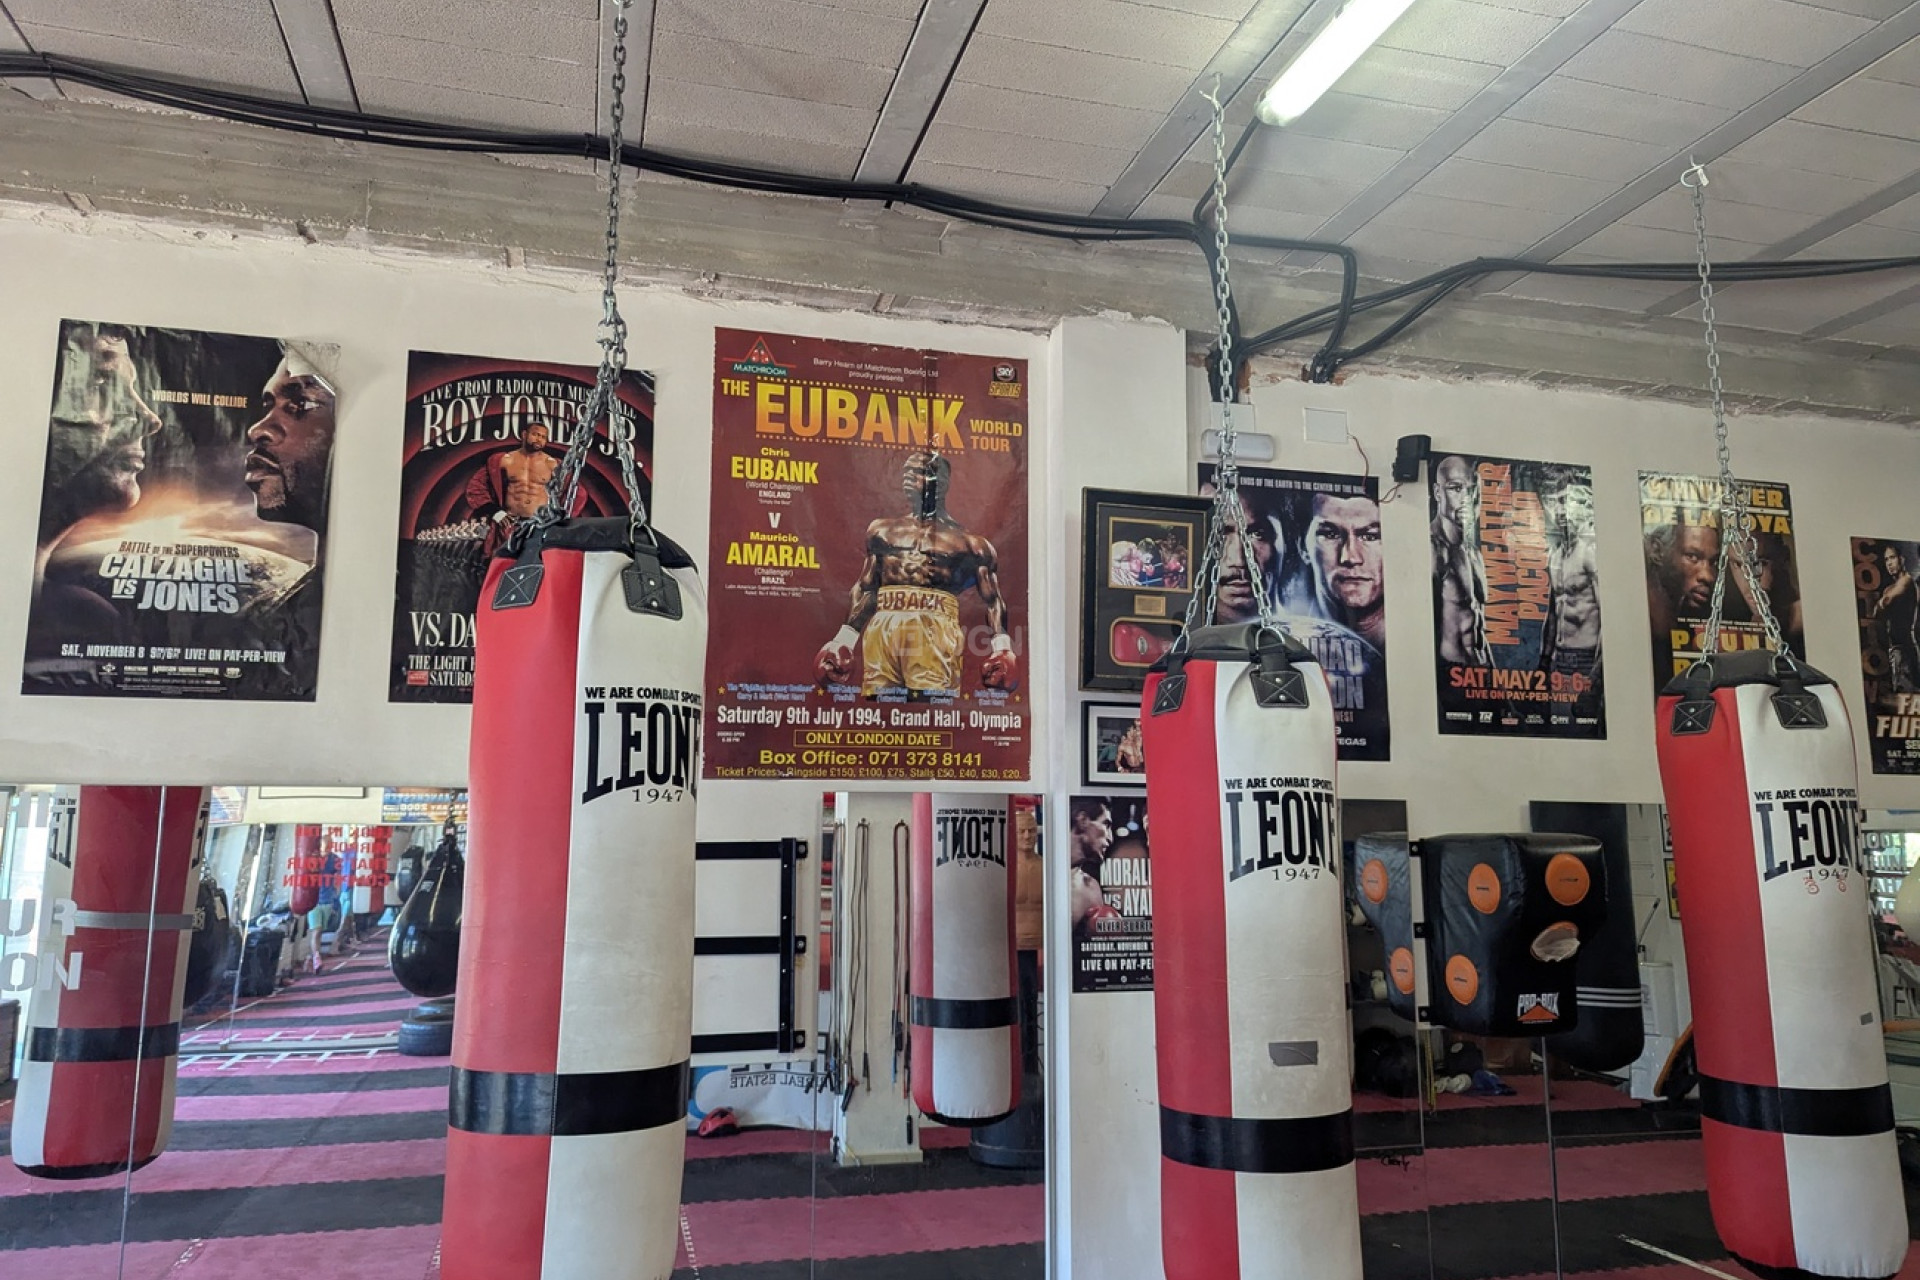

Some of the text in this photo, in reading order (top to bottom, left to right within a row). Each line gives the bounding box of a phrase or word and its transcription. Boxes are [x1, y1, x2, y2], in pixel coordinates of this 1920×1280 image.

[733, 363, 787, 376] MATCHROOM
[813, 357, 832, 367] Barry
[903, 367, 926, 377] Boxing
[848, 370, 904, 383] proudly presents
[423, 384, 453, 404] LIVE
[456, 379, 491, 397] FROM
[496, 379, 534, 395] RADIO
[537, 380, 563, 396] CITY
[721, 378, 750, 397] THE
[988, 381, 1022, 398] SPORTS
[152, 389, 248, 409] WORLDS WILL COLLIDE
[421, 396, 489, 451] ROY
[755, 382, 966, 449] EUBANK
[969, 419, 1023, 437] WORLD
[970, 435, 1011, 452] TOUR
[760, 447, 791, 458] Chris
[731, 456, 819, 484] EUBANK
[745, 481, 804, 493] (World Champion)
[758, 490, 791, 500] ENGLAND
[768, 512, 781, 529] V
[1682, 508, 1717, 529] LA
[749, 531, 800, 543] Mauricio
[119, 541, 151, 554] BATTLE
[162, 546, 175, 555] THE
[175, 544, 240, 558] SUPERPOWERS
[726, 542, 820, 569] AMARAL
[1478, 462, 1520, 645] MAYWEATHER
[98, 553, 253, 584] CALZAGHE
[754, 567, 794, 577] (Challenger)
[761, 576, 787, 585] BRAZIL
[112, 578, 240, 614] VS JONES
[408, 611, 445, 648] VS.
[61, 643, 84, 658] SAT.,
[86, 644, 135, 658] NOVEMBER
[184, 648, 207, 660] LIVE!
[208, 648, 221, 661] ON
[223, 649, 286, 663] PAY-PER-VIEW
[408, 654, 468, 671] THE LIGHT
[429, 670, 474, 687] SATURD
[1450, 667, 1490, 689] SAT
[1492, 667, 1534, 690] MAY
[1535, 669, 1547, 691] 2
[585, 686, 606, 700] WE
[609, 686, 634, 699] ARE
[636, 687, 680, 701] COMBAT
[1465, 689, 1579, 703] LIVE ON PAY-PER-VIEW
[717, 704, 1022, 733] Saturday 9th July 1994, Grand Hall, Olympia
[805, 732, 942, 746] ONLY LONDON DATE
[582, 702, 703, 805] LEONE
[759, 749, 983, 767] Box Office: 071 373 8141
[714, 766, 744, 777] Ticket
[829, 767, 856, 779] £150,
[910, 768, 935, 778] Stalls
[1224, 778, 1243, 790] WE
[1246, 777, 1268, 789] ARE
[1270, 777, 1311, 788] COMBAT
[632, 788, 684, 805] 1947
[1754, 791, 1773, 801] WE
[1775, 789, 1797, 800] ARE
[1798, 788, 1836, 798] COMBAT
[1225, 790, 1339, 882] LEONE
[1755, 799, 1863, 882] LEONE
[1271, 868, 1321, 882] 1947
[1804, 868, 1850, 882] 1947
[1096, 919, 1122, 933] NEVER
[1080, 959, 1103, 972] LIVE
[1104, 959, 1118, 972] ON
